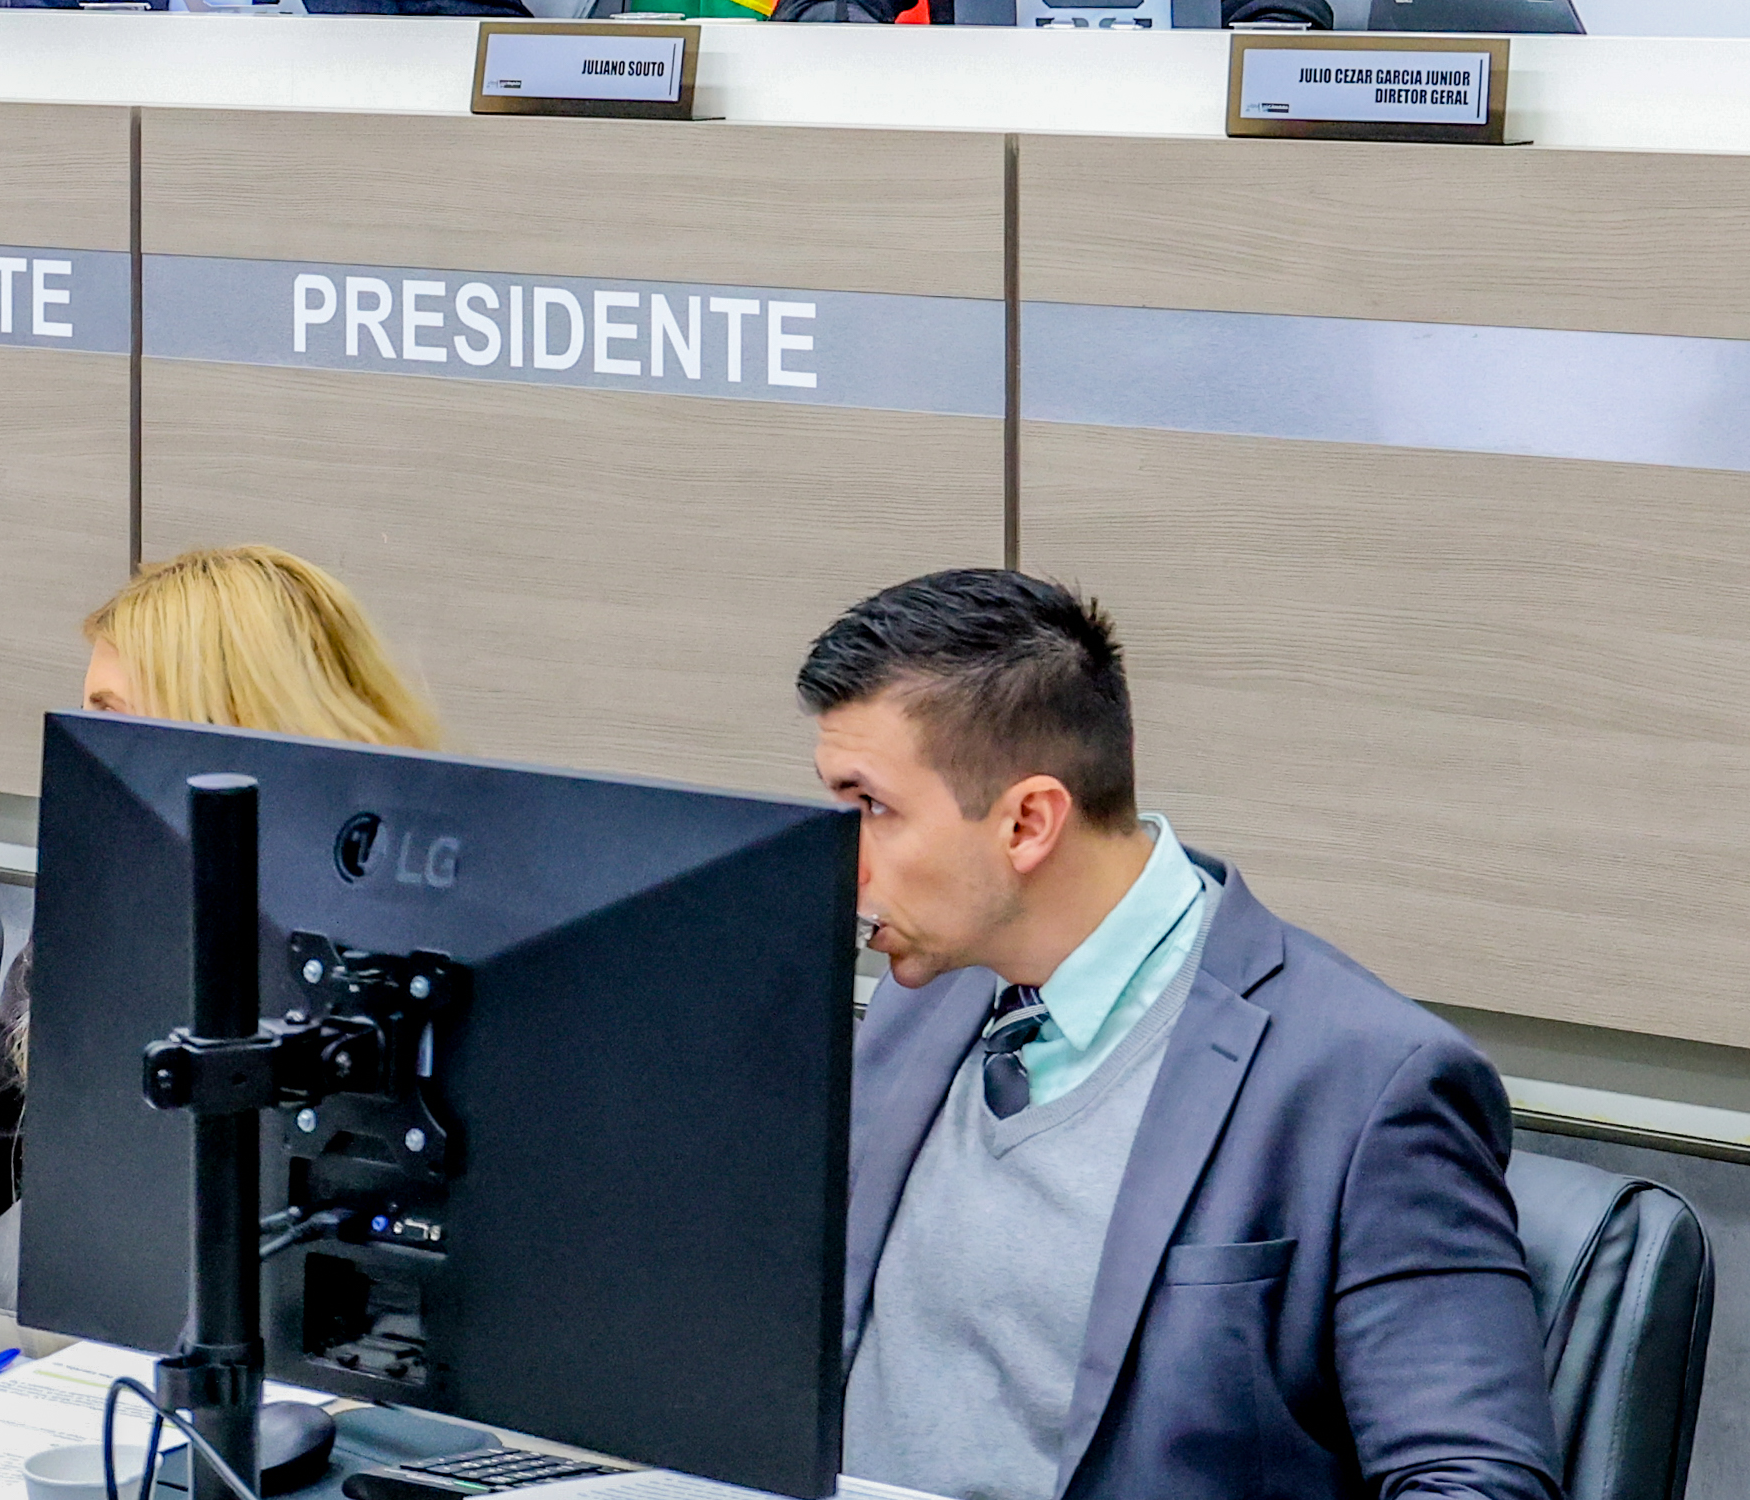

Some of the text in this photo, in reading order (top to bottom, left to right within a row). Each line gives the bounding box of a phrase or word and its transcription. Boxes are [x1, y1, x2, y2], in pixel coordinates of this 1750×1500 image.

[581, 59, 665, 77] JULIANO SOUTO
[1299, 68, 1471, 87] JULIO CEZAR GARCIA JUNIOR
[1375, 89, 1469, 105] DIRETOR GERAL
[293, 273, 818, 389] PRESIDENTE
[395, 832, 460, 888] LG
